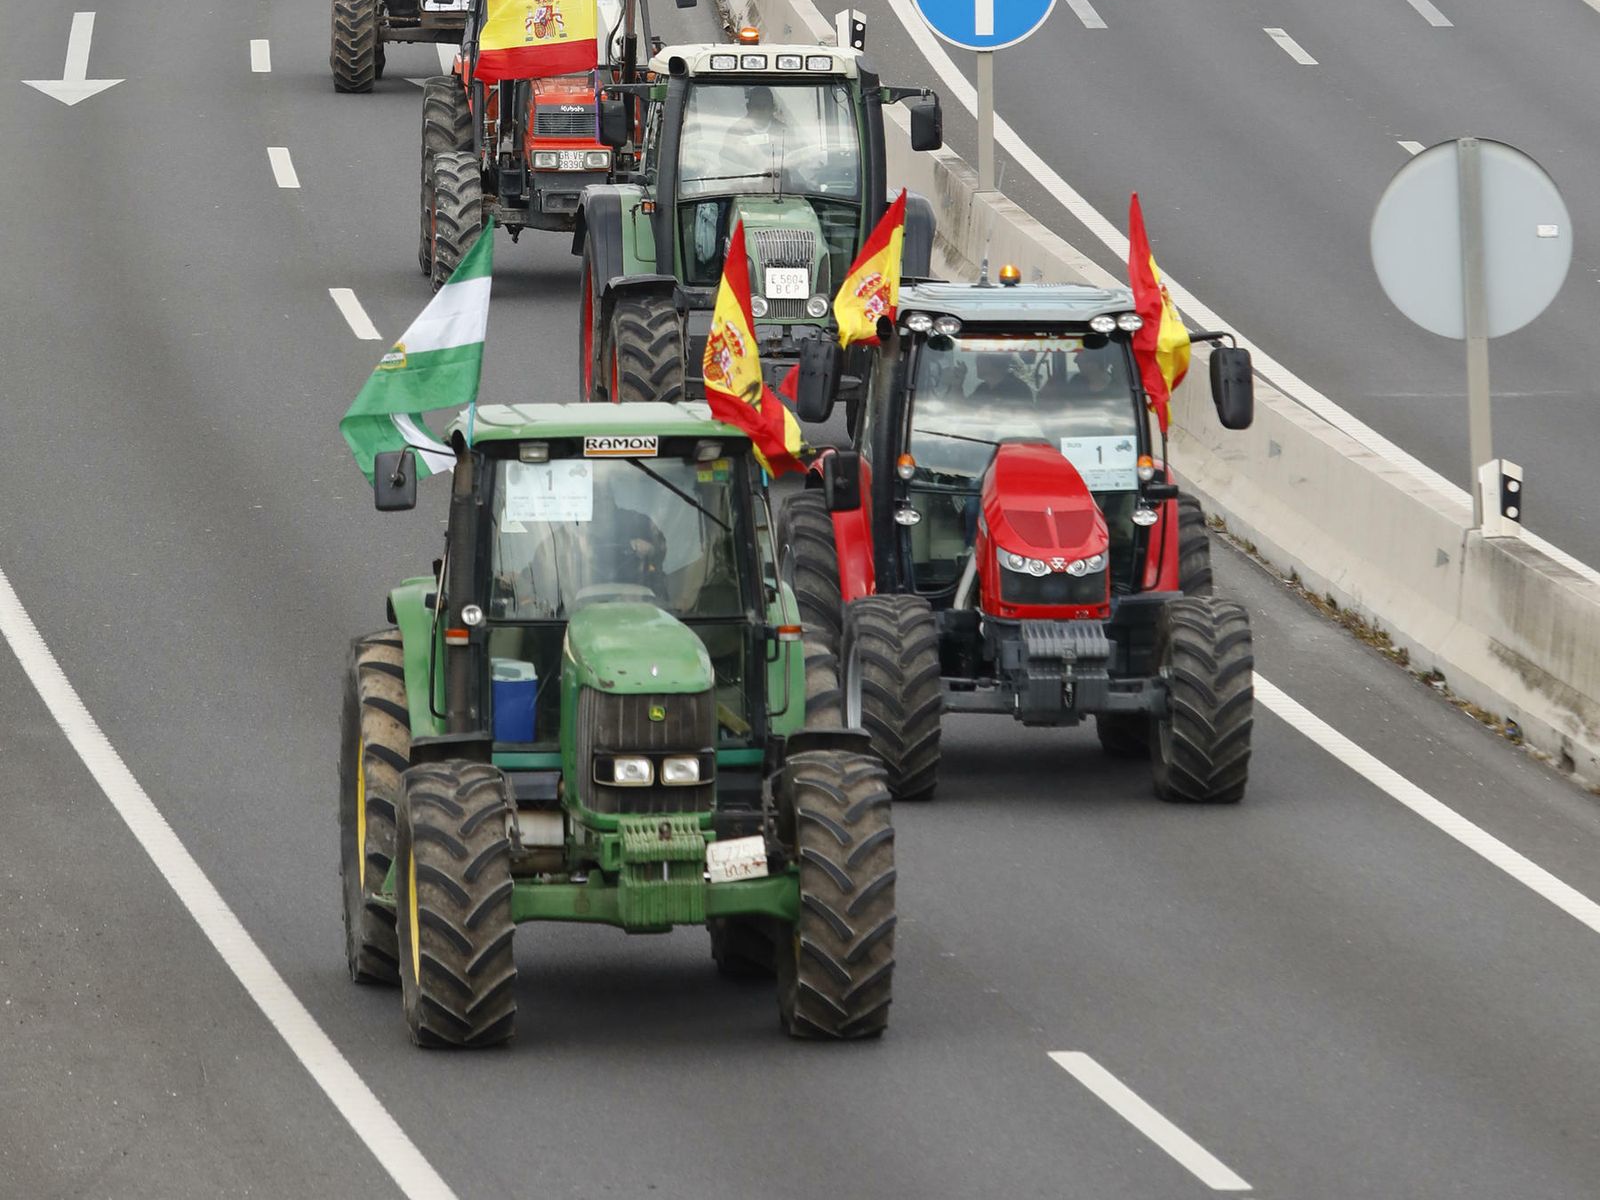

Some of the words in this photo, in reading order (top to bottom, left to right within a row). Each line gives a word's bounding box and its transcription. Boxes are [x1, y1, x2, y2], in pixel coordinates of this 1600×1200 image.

[559, 160, 584, 169] 28390
[585, 438, 657, 449] RAMON
[1096, 445, 1102, 465] 1
[546, 469, 552, 491] 1
